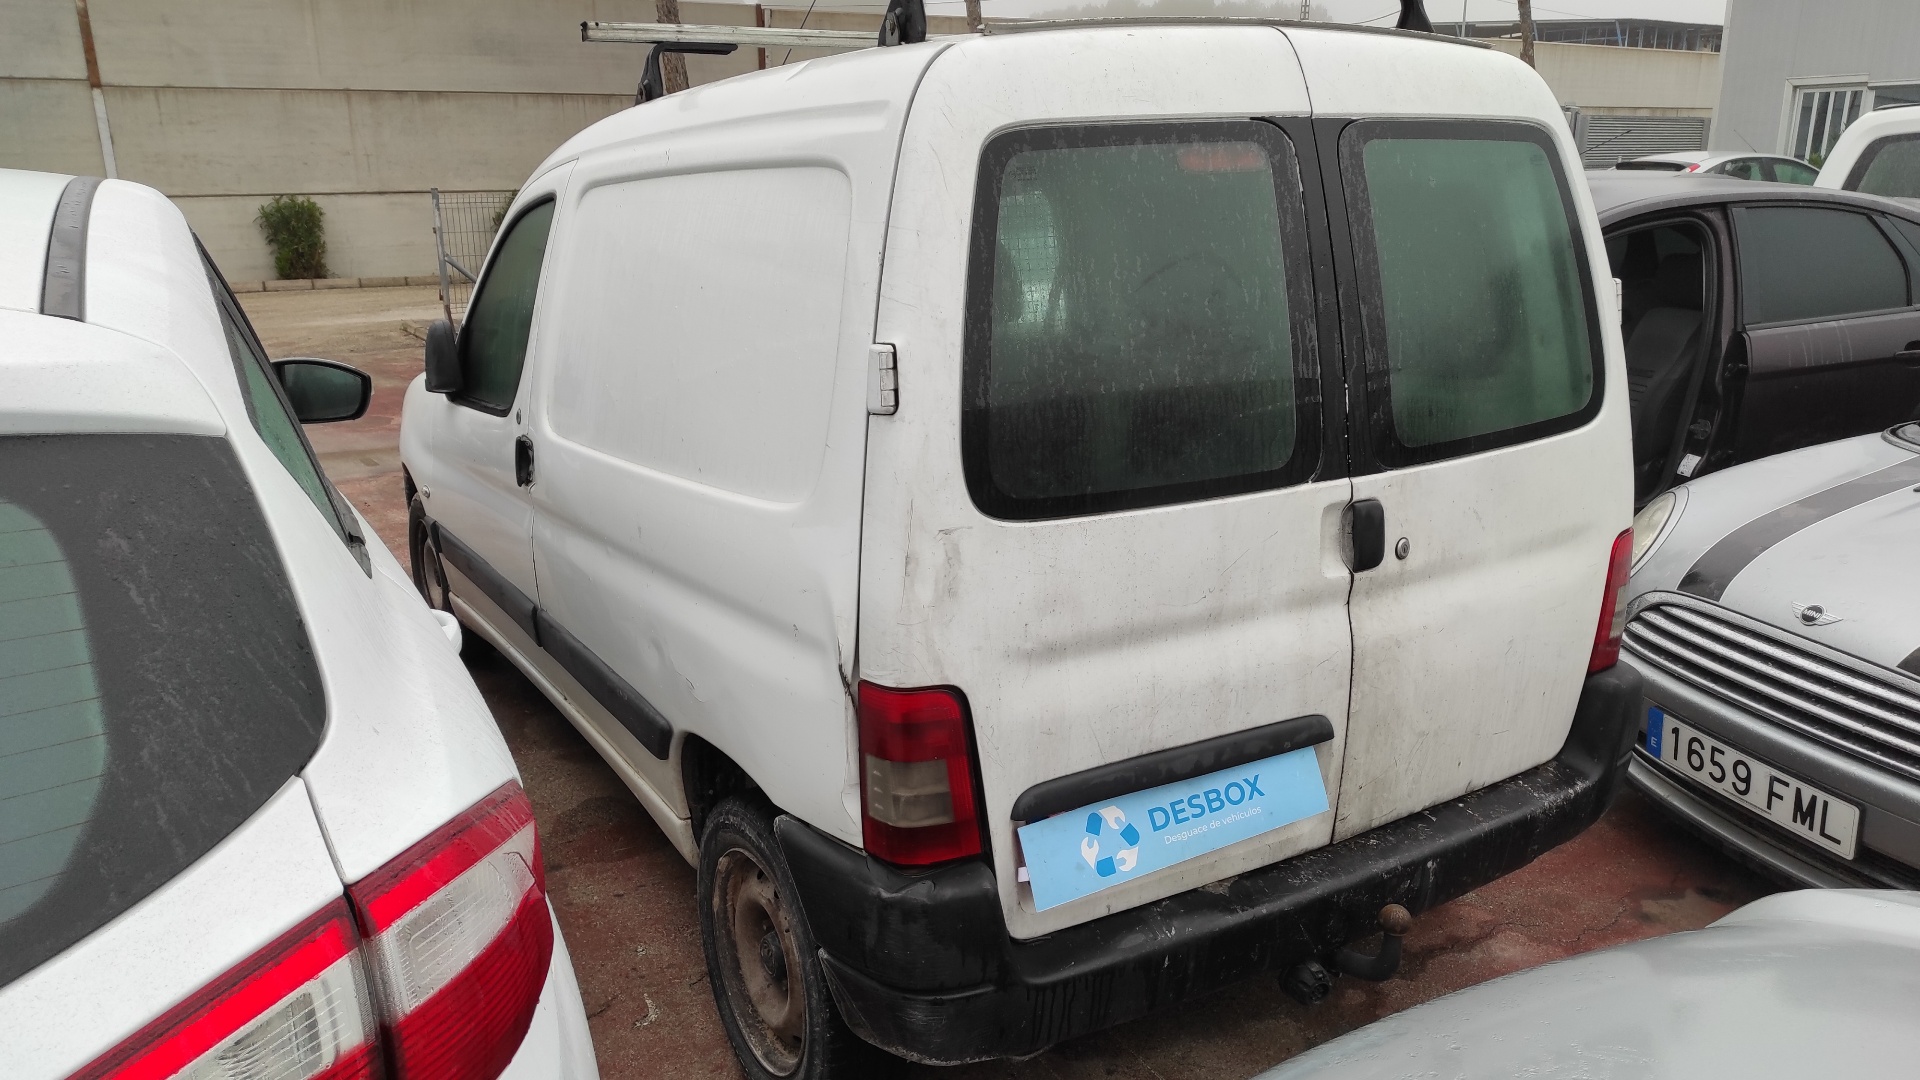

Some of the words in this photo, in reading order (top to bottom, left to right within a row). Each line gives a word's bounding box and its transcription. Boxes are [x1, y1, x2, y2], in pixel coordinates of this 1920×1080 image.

[1803, 608, 1821, 619] MINI
[1650, 736, 1658, 748] E
[1147, 773, 1266, 833] DESBOX
[1671, 726, 1752, 796] 1659
[1766, 774, 1842, 846] FML
[1164, 824, 1208, 845] Desguace
[1209, 819, 1221, 829] de
[1222, 805, 1262, 825] vehículos
